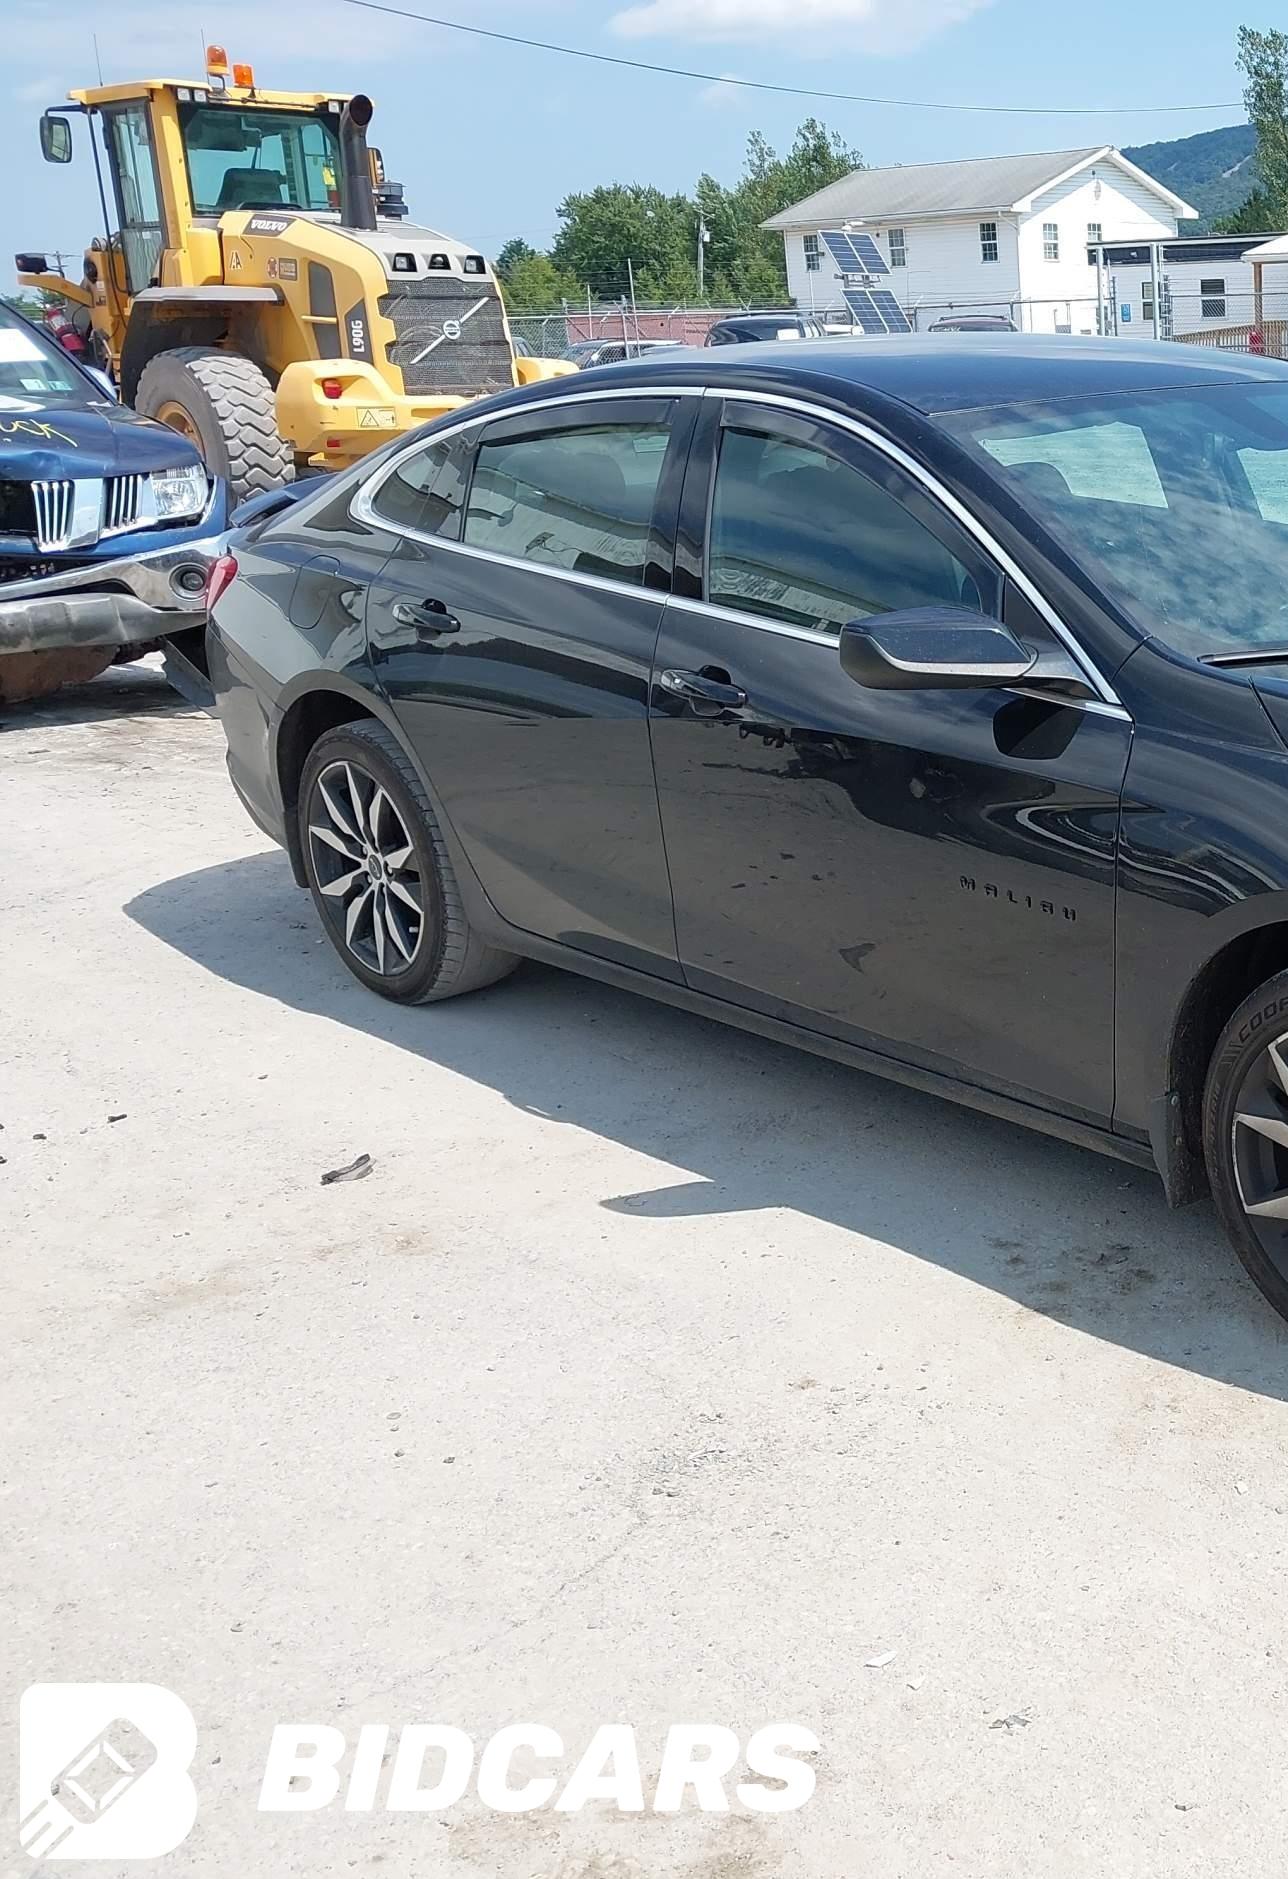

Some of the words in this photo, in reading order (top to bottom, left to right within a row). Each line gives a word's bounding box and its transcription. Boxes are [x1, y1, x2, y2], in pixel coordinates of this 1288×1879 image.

[250, 218, 288, 231] VOLVO
[351, 319, 365, 353] L90G
[960, 875, 1077, 921] MALIBU
